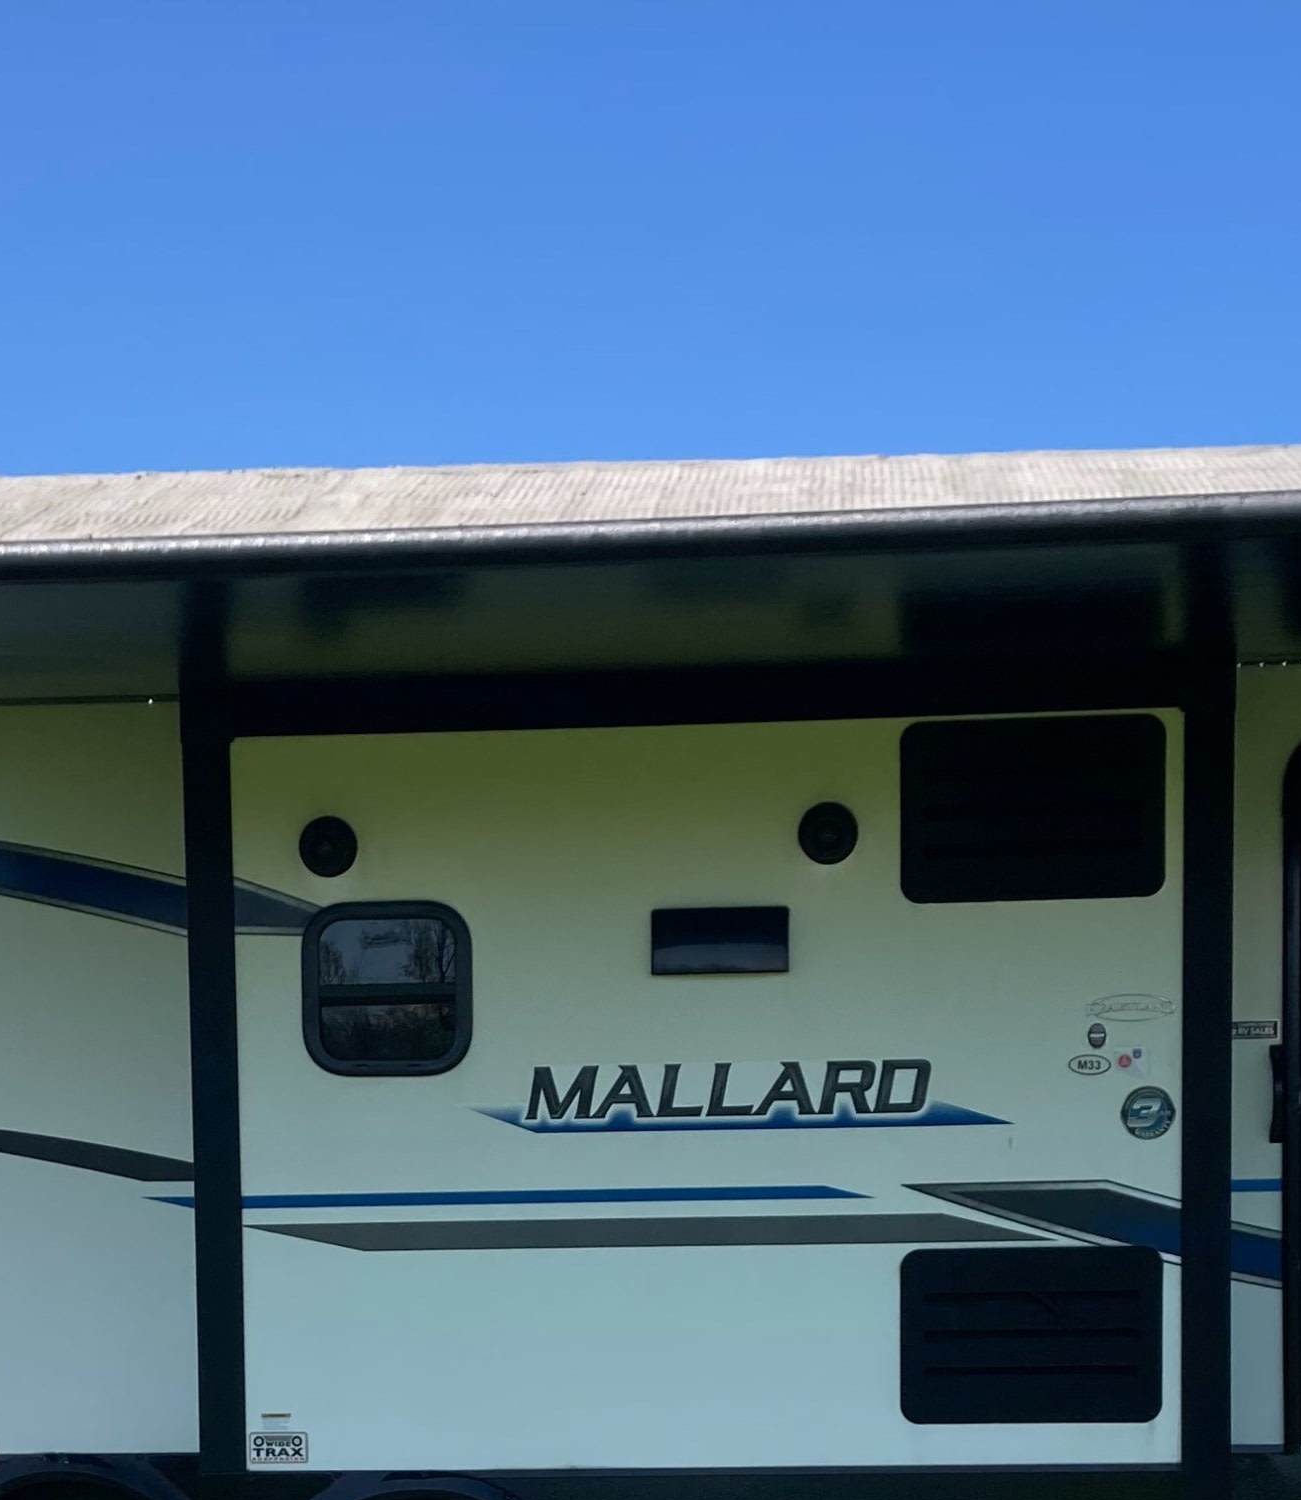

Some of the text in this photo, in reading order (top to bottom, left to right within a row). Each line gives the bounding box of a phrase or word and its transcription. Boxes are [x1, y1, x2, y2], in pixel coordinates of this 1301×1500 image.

[1238, 1027, 1249, 1035] RV
[1250, 1025, 1275, 1035] SALES
[1077, 1060, 1101, 1070] M33
[524, 1059, 932, 1120] MALLARD
[252, 1447, 303, 1457] TRAX
